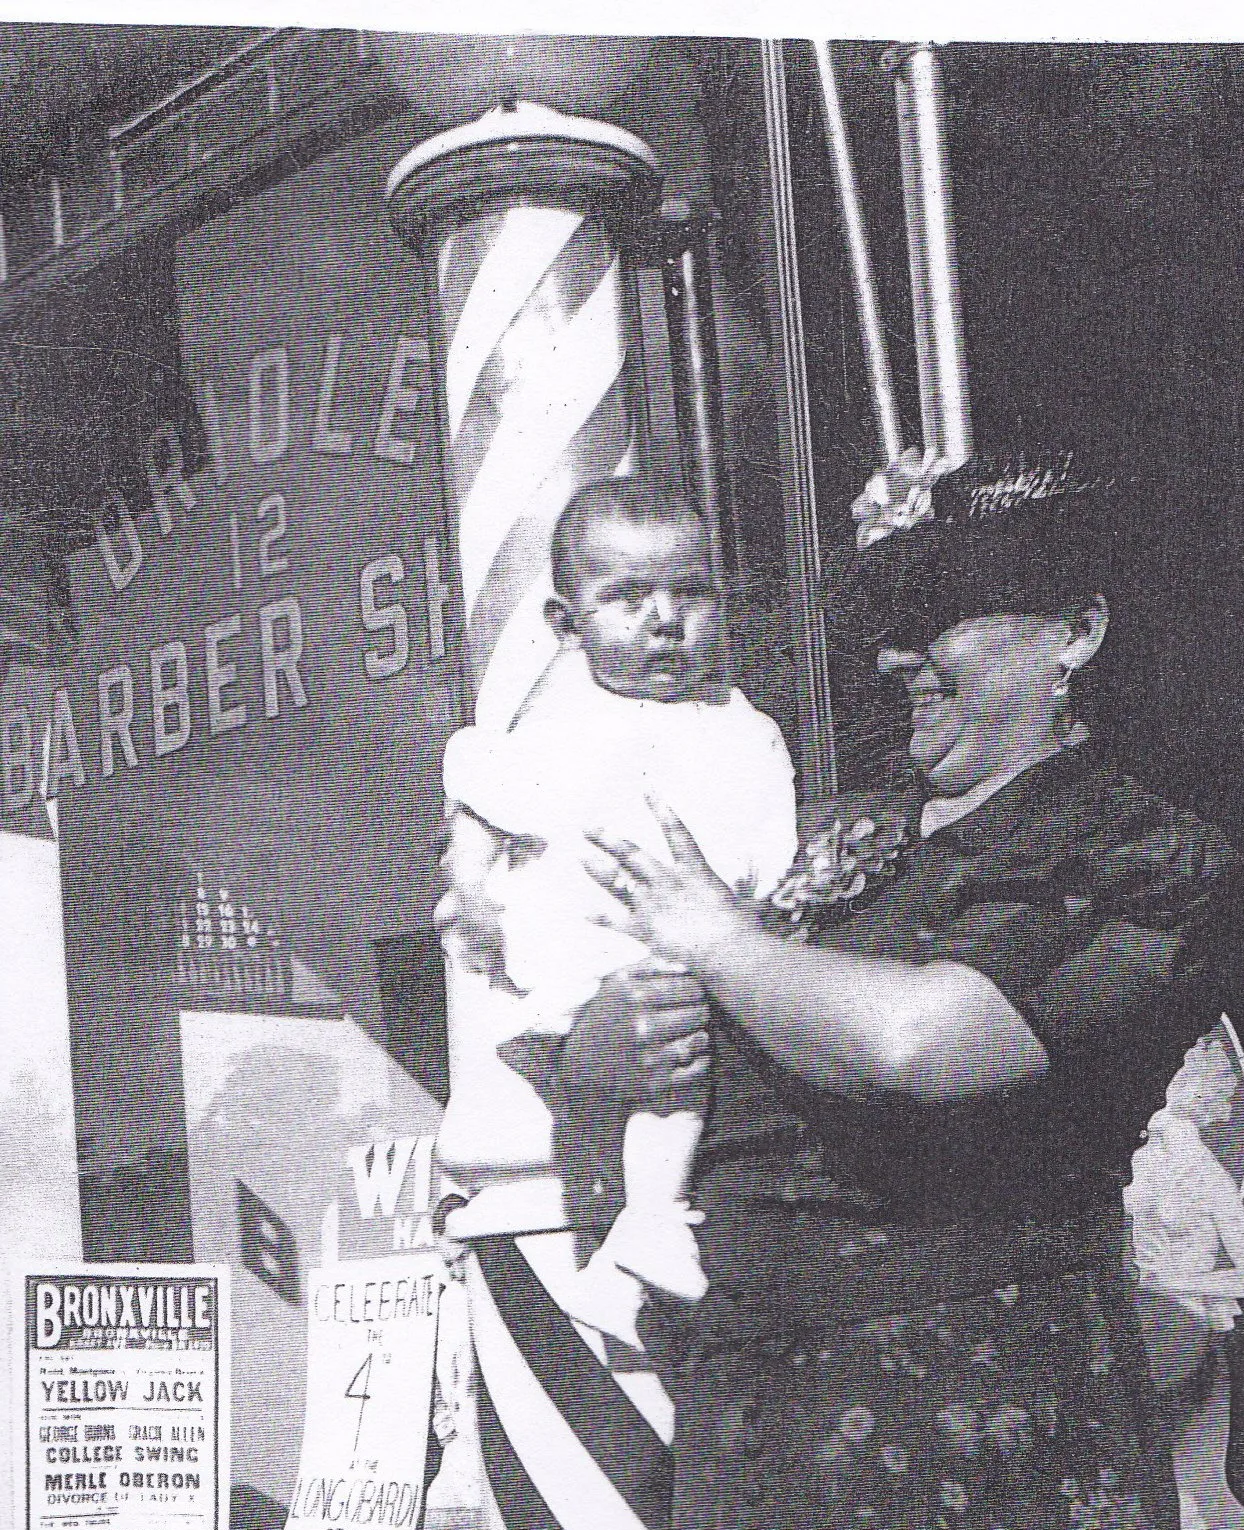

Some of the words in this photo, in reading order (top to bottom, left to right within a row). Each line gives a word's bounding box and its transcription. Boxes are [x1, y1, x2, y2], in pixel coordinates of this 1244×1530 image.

[95, 334, 430, 592] ORIOLE
[230, 493, 289, 589] 12
[1, 596, 308, 812] BARBER
[36, 1282, 213, 1349] BRONXVILLE
[41, 1380, 129, 1403] YELLOW
[142, 1380, 204, 1403] JACK
[46, 1444, 123, 1464] COLLEGE
[134, 1445, 199, 1464] SWING
[45, 1471, 107, 1491] MERLE
[119, 1471, 200, 1490] OBERON
[47, 1491, 109, 1505] DIVORCE
